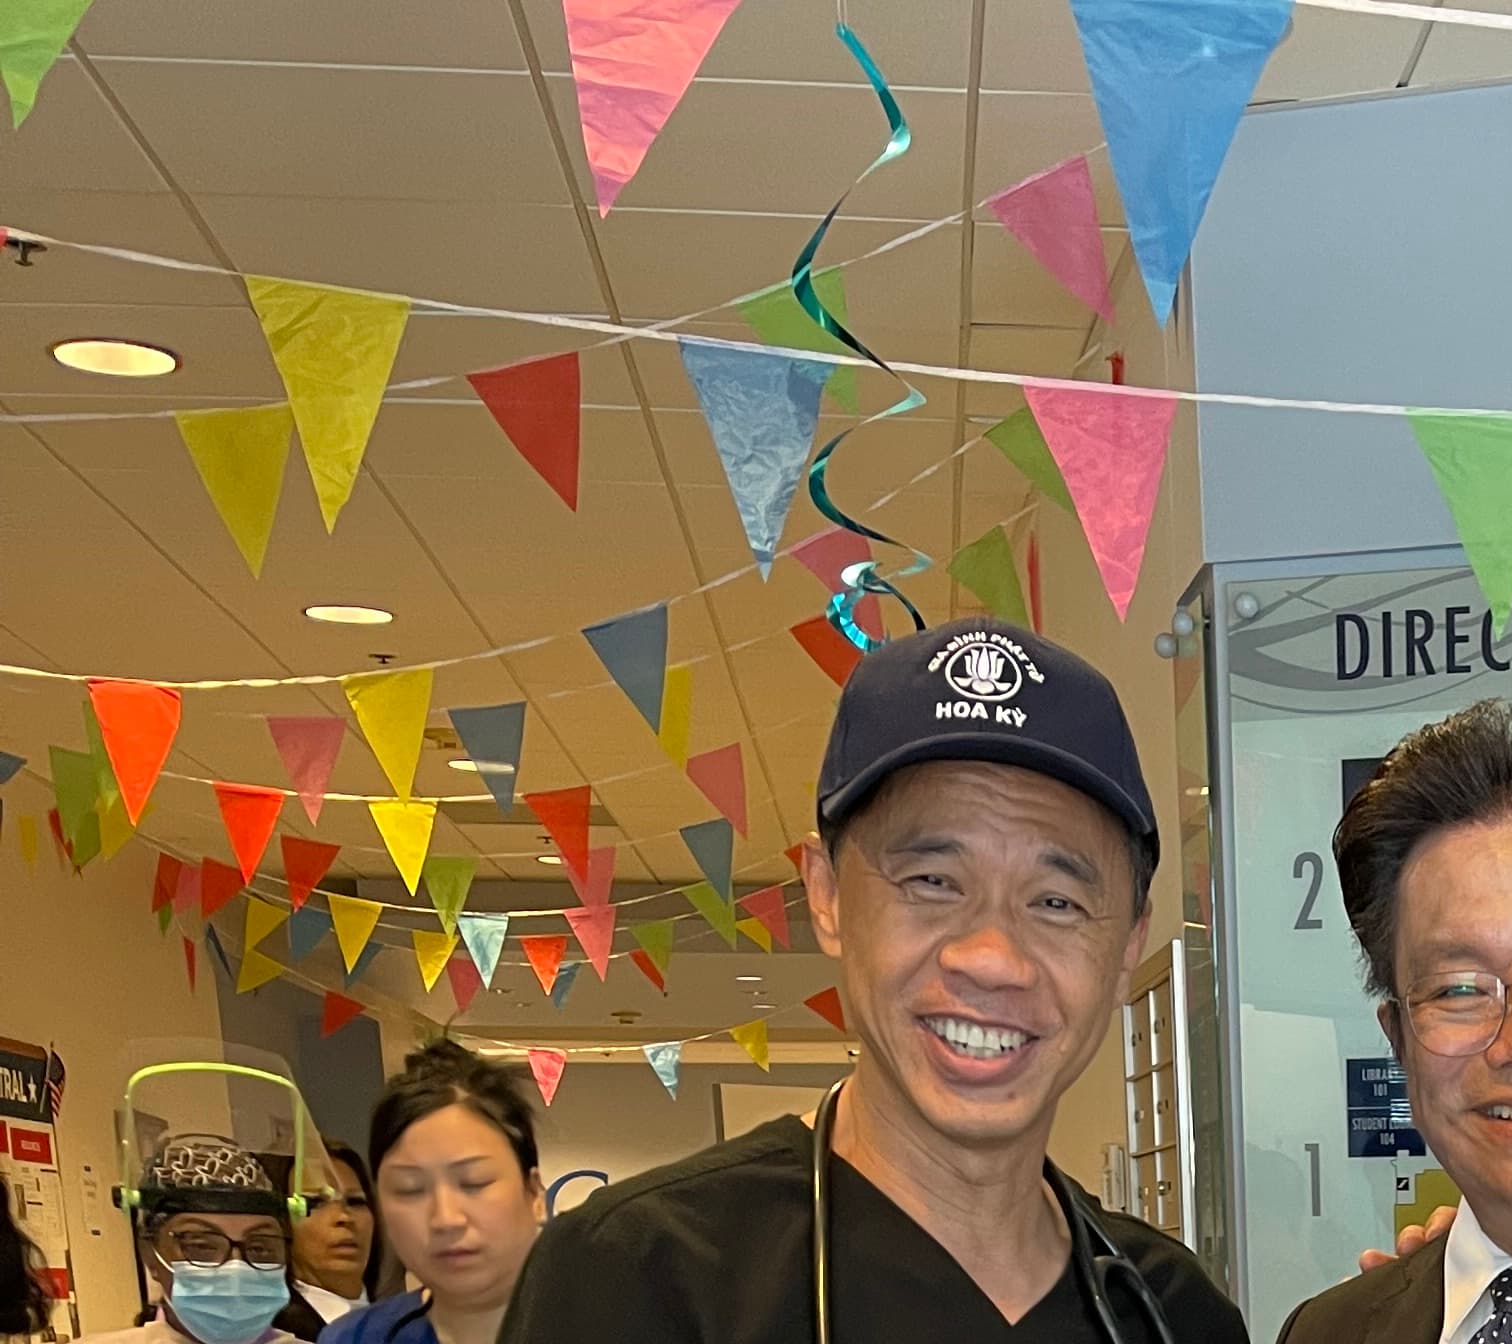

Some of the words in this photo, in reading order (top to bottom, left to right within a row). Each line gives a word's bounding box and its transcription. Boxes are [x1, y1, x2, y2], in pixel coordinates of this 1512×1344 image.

[935, 700, 989, 719] HOA
[1292, 851, 1324, 930] 2
[1373, 1083, 1389, 1097] 101
[1351, 1117, 1388, 1131] STUDENT
[1380, 1132, 1396, 1145] 104
[1304, 1143, 1321, 1217] 1
